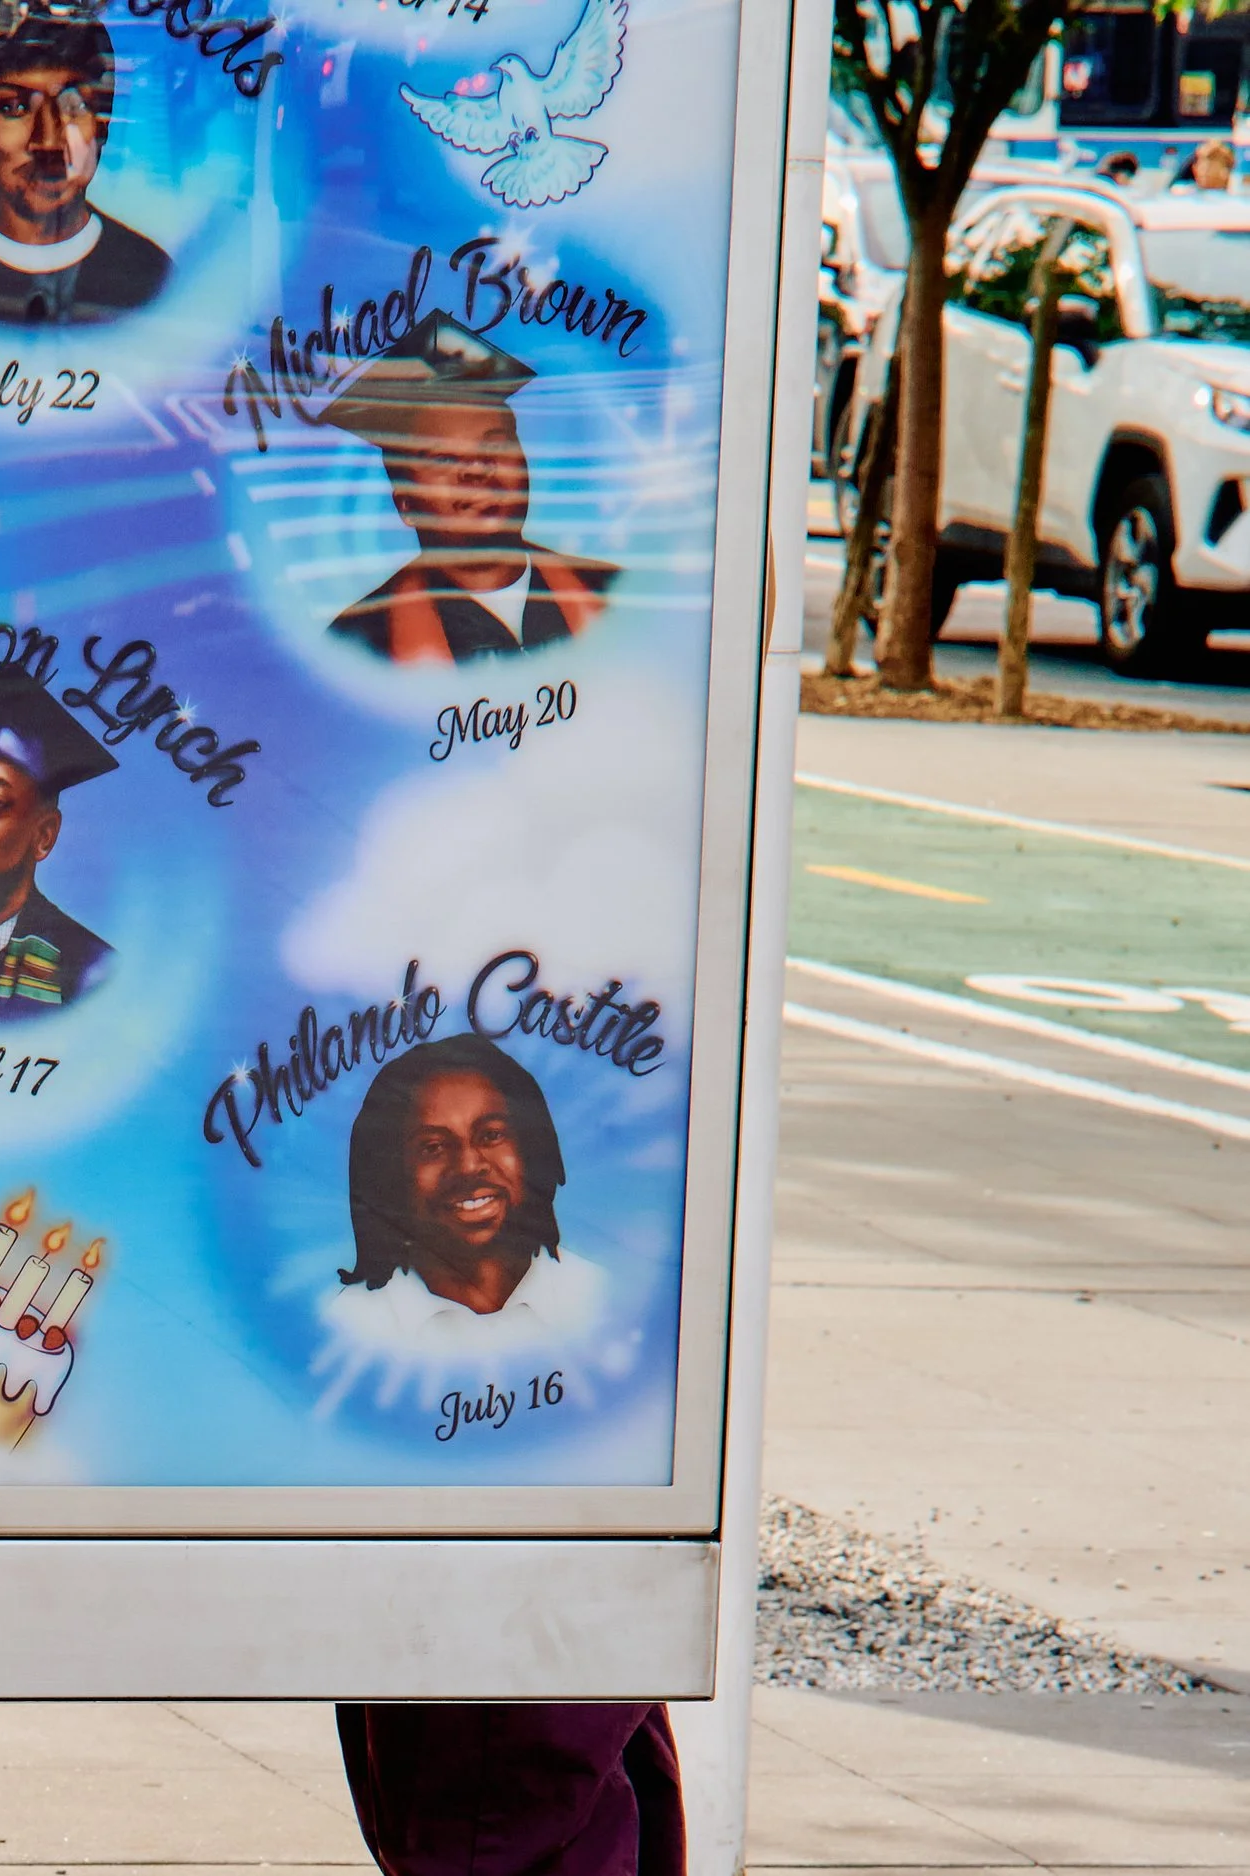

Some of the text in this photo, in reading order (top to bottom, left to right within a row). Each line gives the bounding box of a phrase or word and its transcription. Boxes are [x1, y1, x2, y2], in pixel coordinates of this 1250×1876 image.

[128, 0, 284, 97] ods
[50, 369, 101, 409] 22
[223, 236, 649, 452] Michael Brown
[62, 635, 262, 807] Lynch
[429, 679, 578, 762] May 20
[10, 1056, 60, 1096] 17
[203, 950, 666, 1168] Philando Castile
[435, 1370, 564, 1441] July 16
